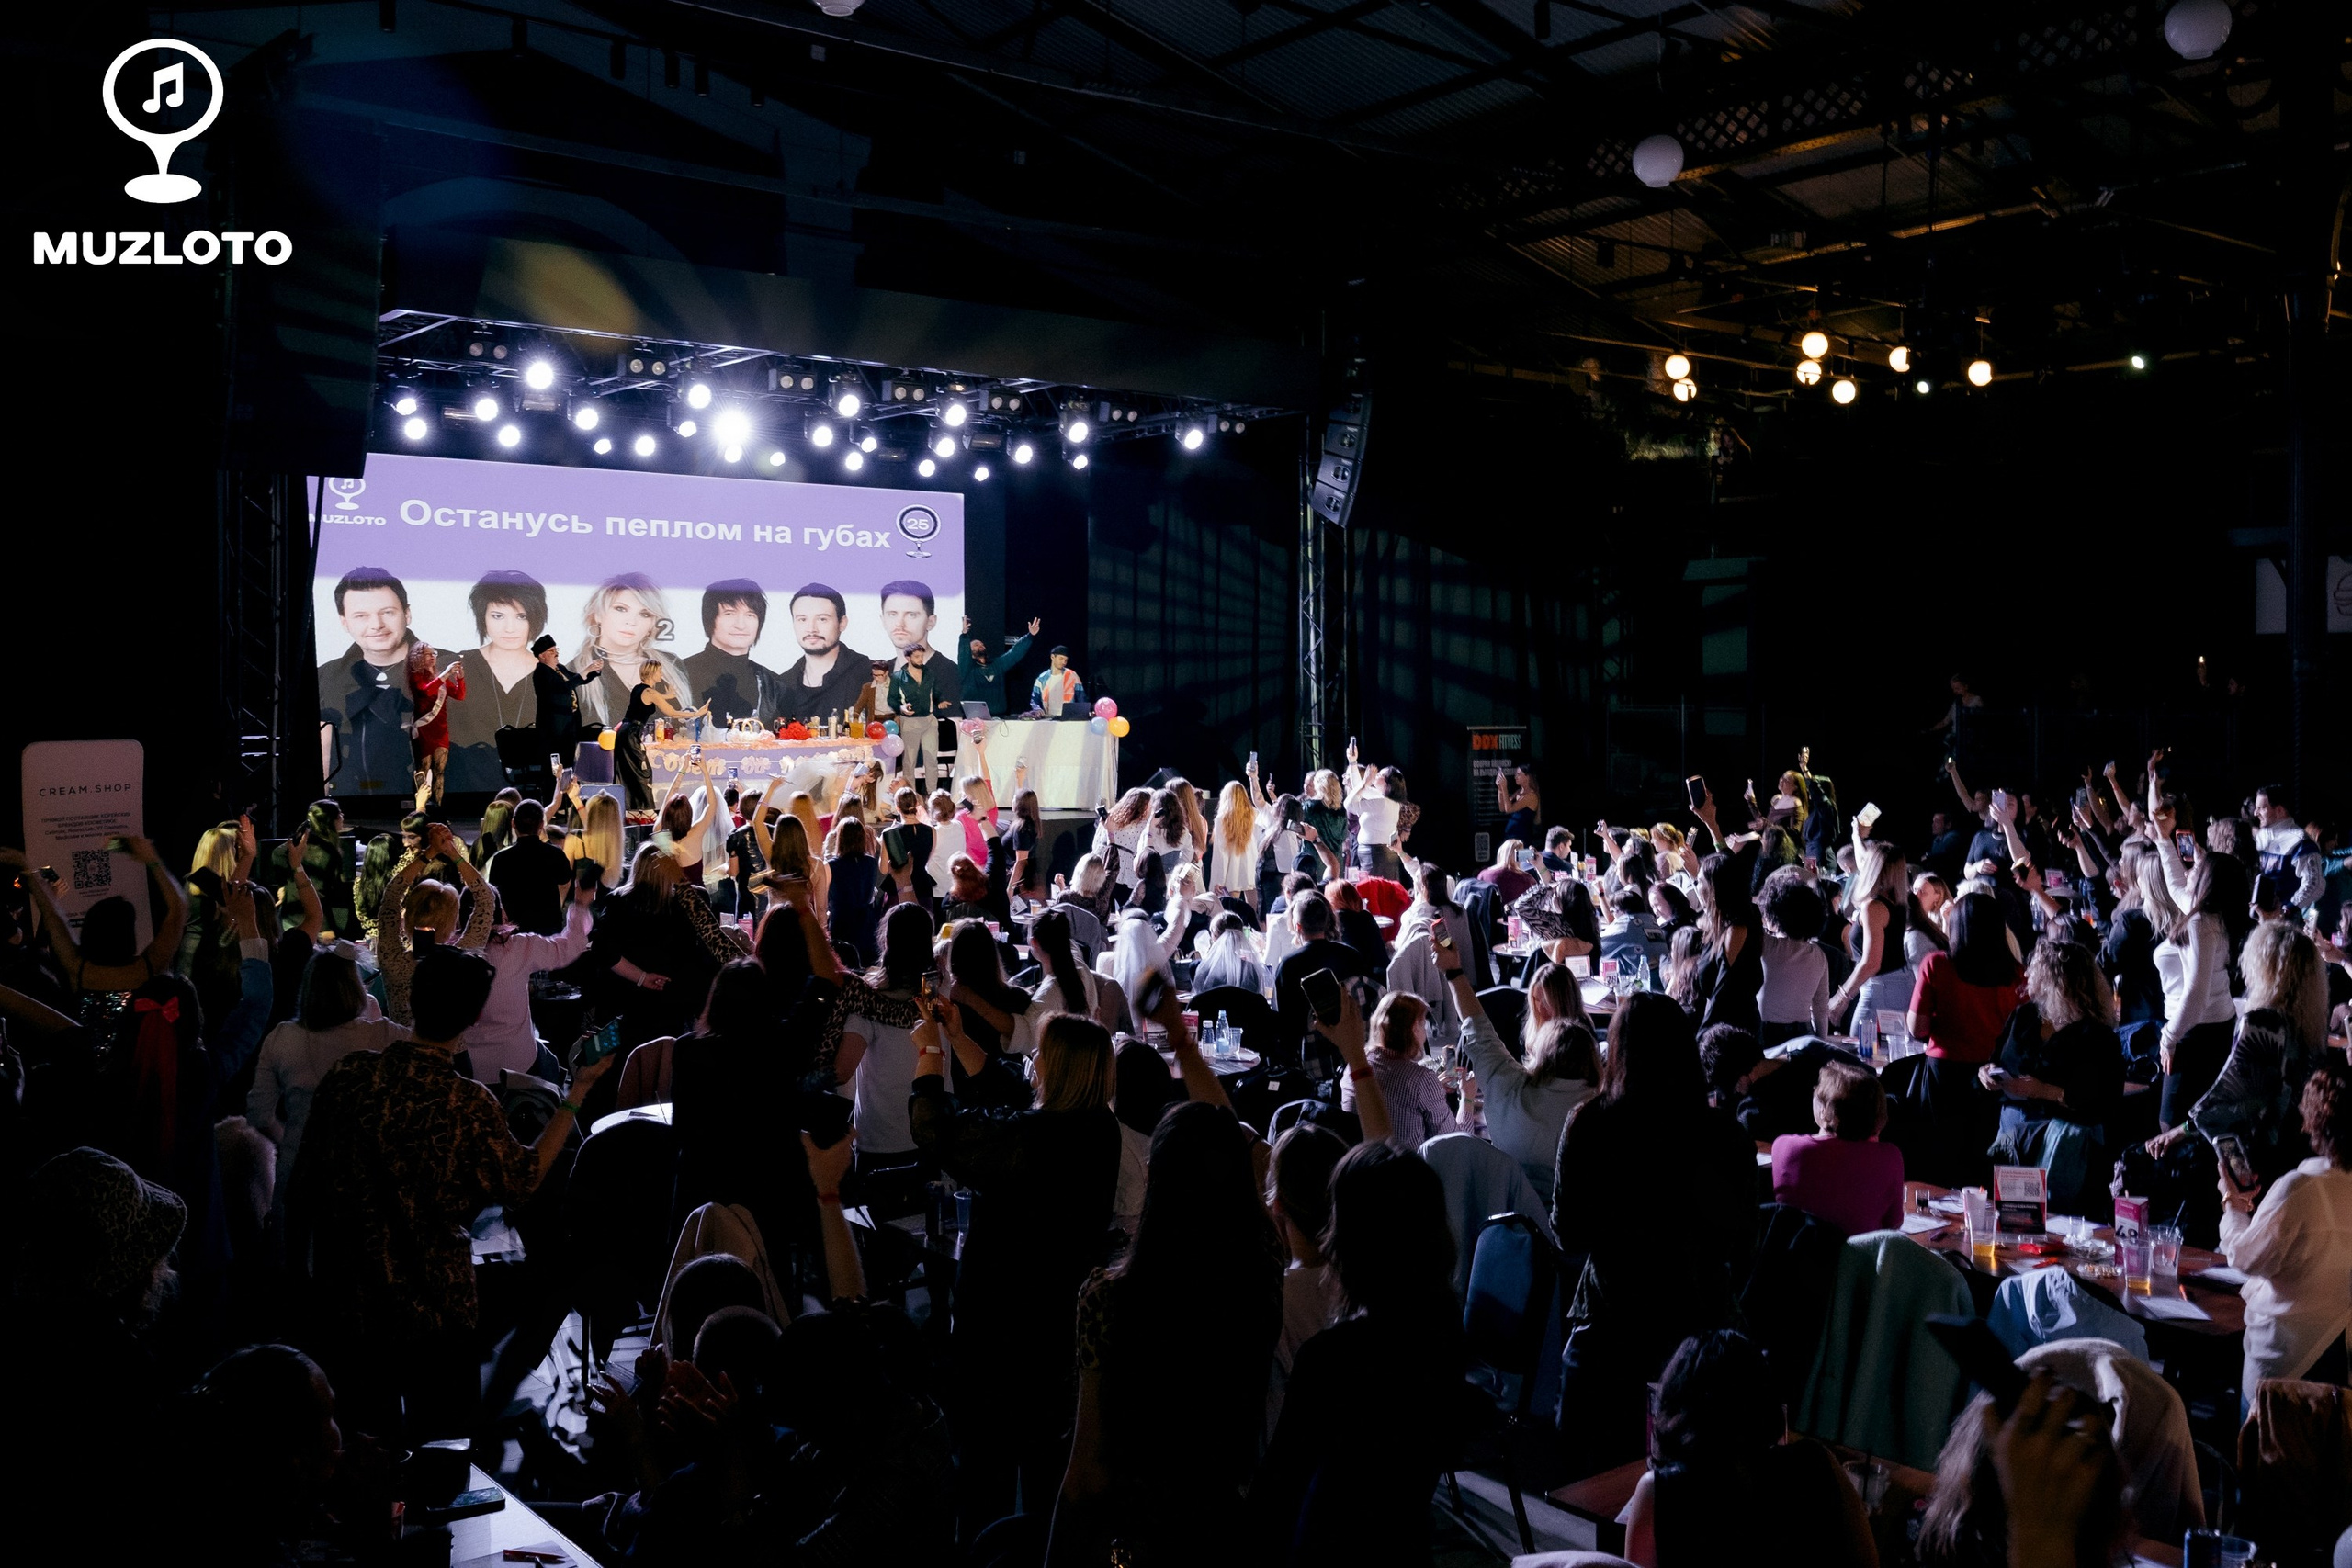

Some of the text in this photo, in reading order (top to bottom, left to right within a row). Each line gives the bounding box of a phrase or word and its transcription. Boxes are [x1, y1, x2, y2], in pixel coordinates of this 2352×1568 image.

[400, 499, 892, 551] Останусь пеплом на губах
[907, 518, 930, 530] 25
[655, 618, 675, 641] 2
